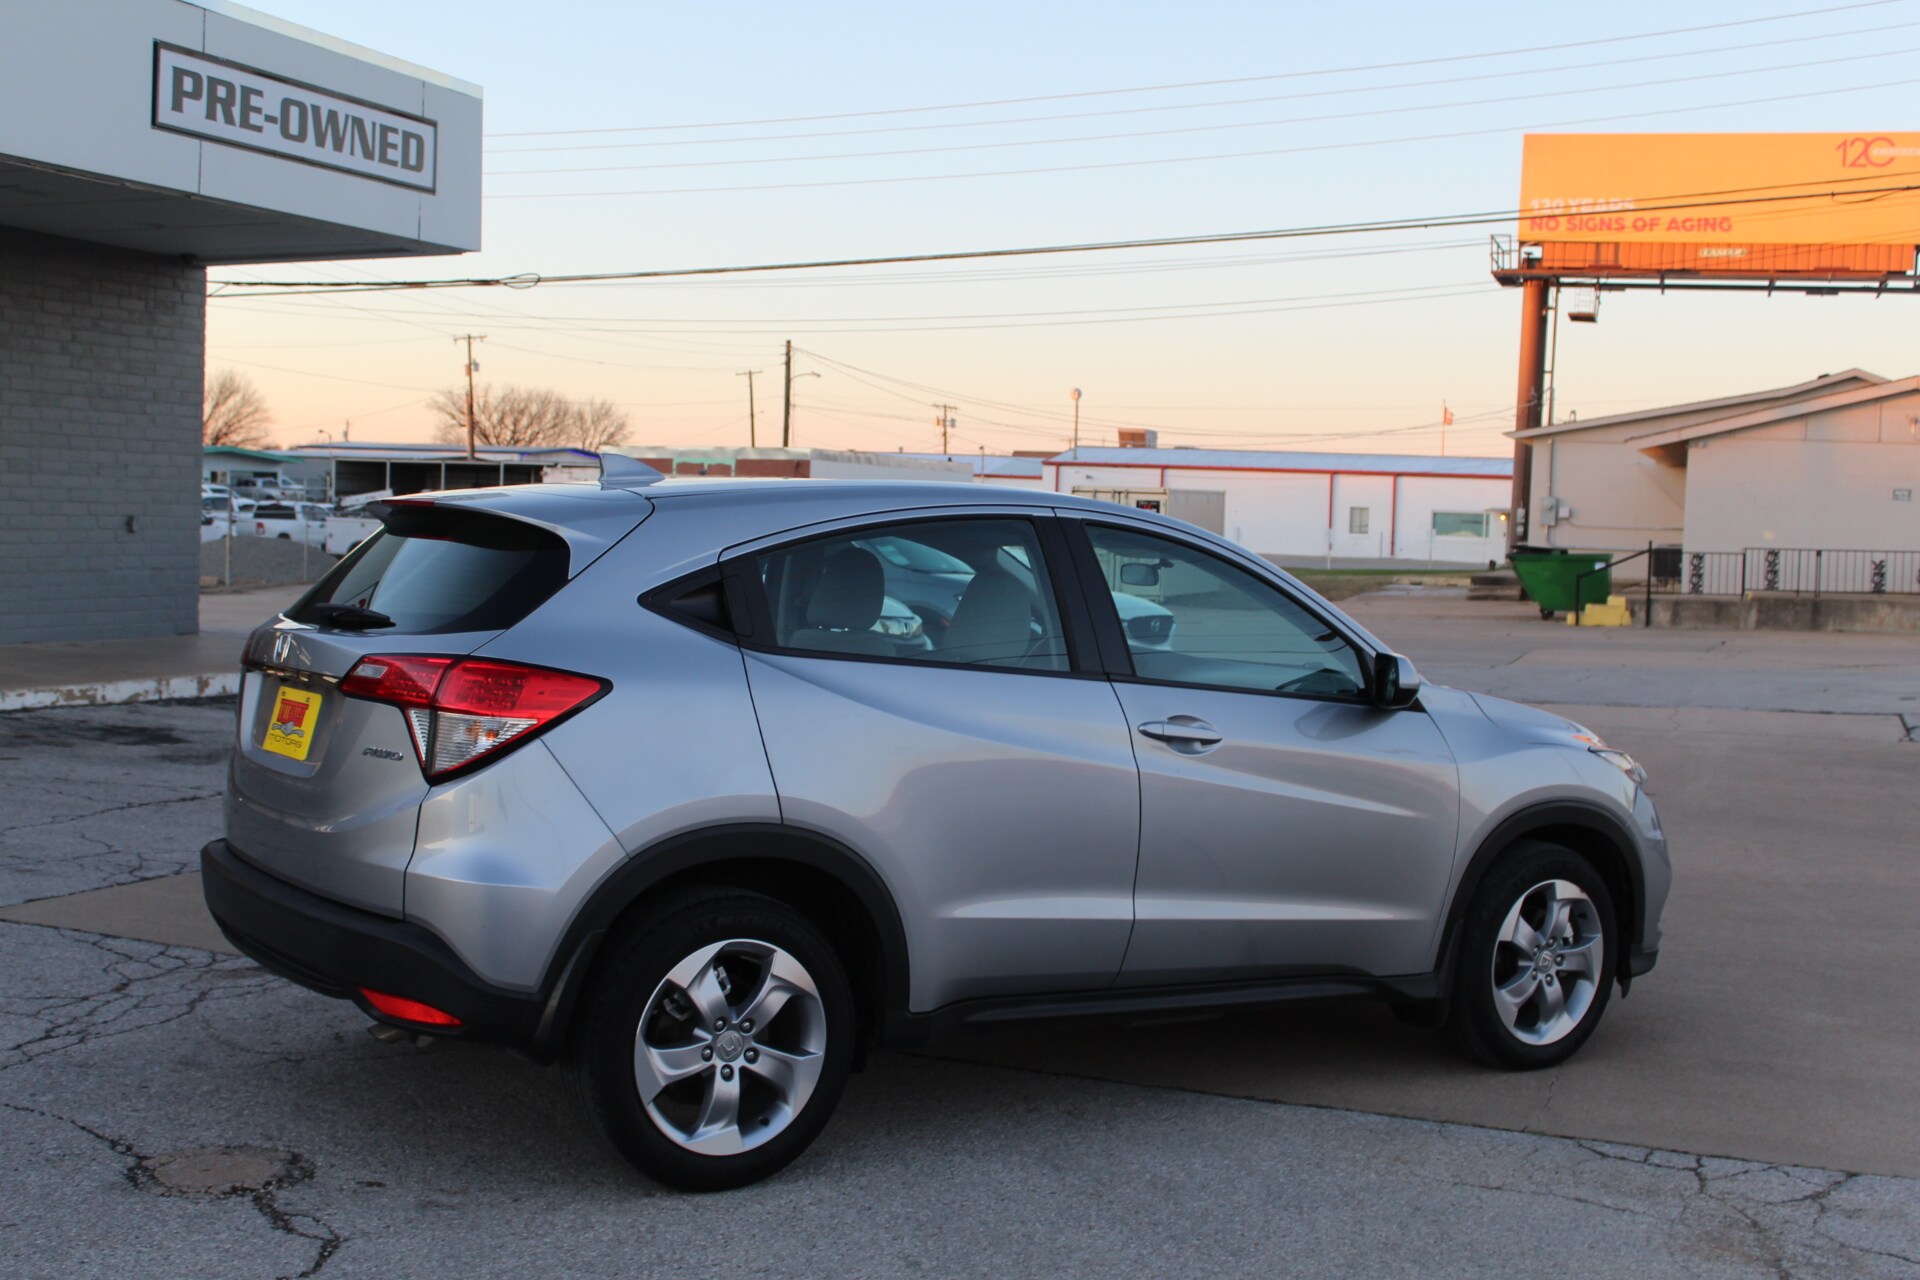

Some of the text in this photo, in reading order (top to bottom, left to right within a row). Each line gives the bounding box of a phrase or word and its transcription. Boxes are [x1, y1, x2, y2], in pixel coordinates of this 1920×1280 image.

[171, 65, 425, 173] PRE-OWNED
[1530, 216, 1732, 232] NO SIGNS OF AGING
